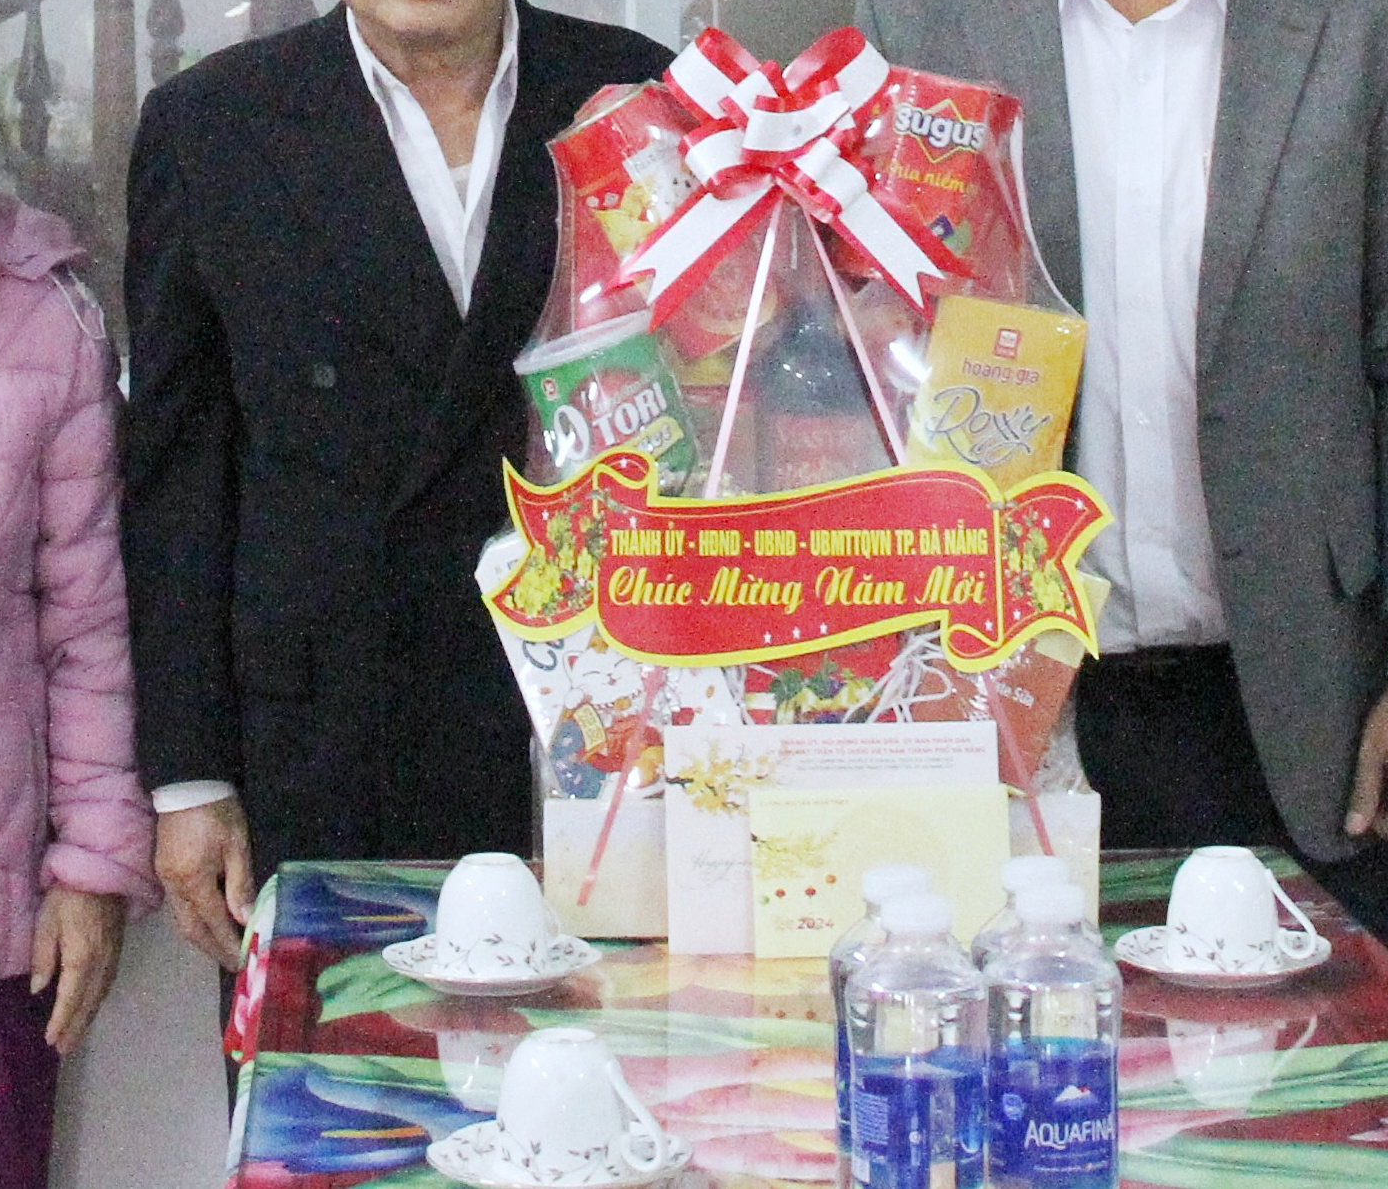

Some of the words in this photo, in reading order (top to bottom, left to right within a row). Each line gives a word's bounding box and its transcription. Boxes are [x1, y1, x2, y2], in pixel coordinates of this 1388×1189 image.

[894, 104, 986, 150] sugus
[664, 520, 686, 557] ỦY
[810, 528, 892, 560] UBMTTQVN
[894, 528, 917, 556] TP.
[918, 522, 942, 556] ĐÀ
[943, 518, 989, 556] NẴNG
[608, 566, 693, 607] Chúc
[699, 566, 805, 616] Mừng
[814, 565, 907, 606] Năm
[914, 565, 988, 605] Mới
[797, 916, 835, 930] 2024
